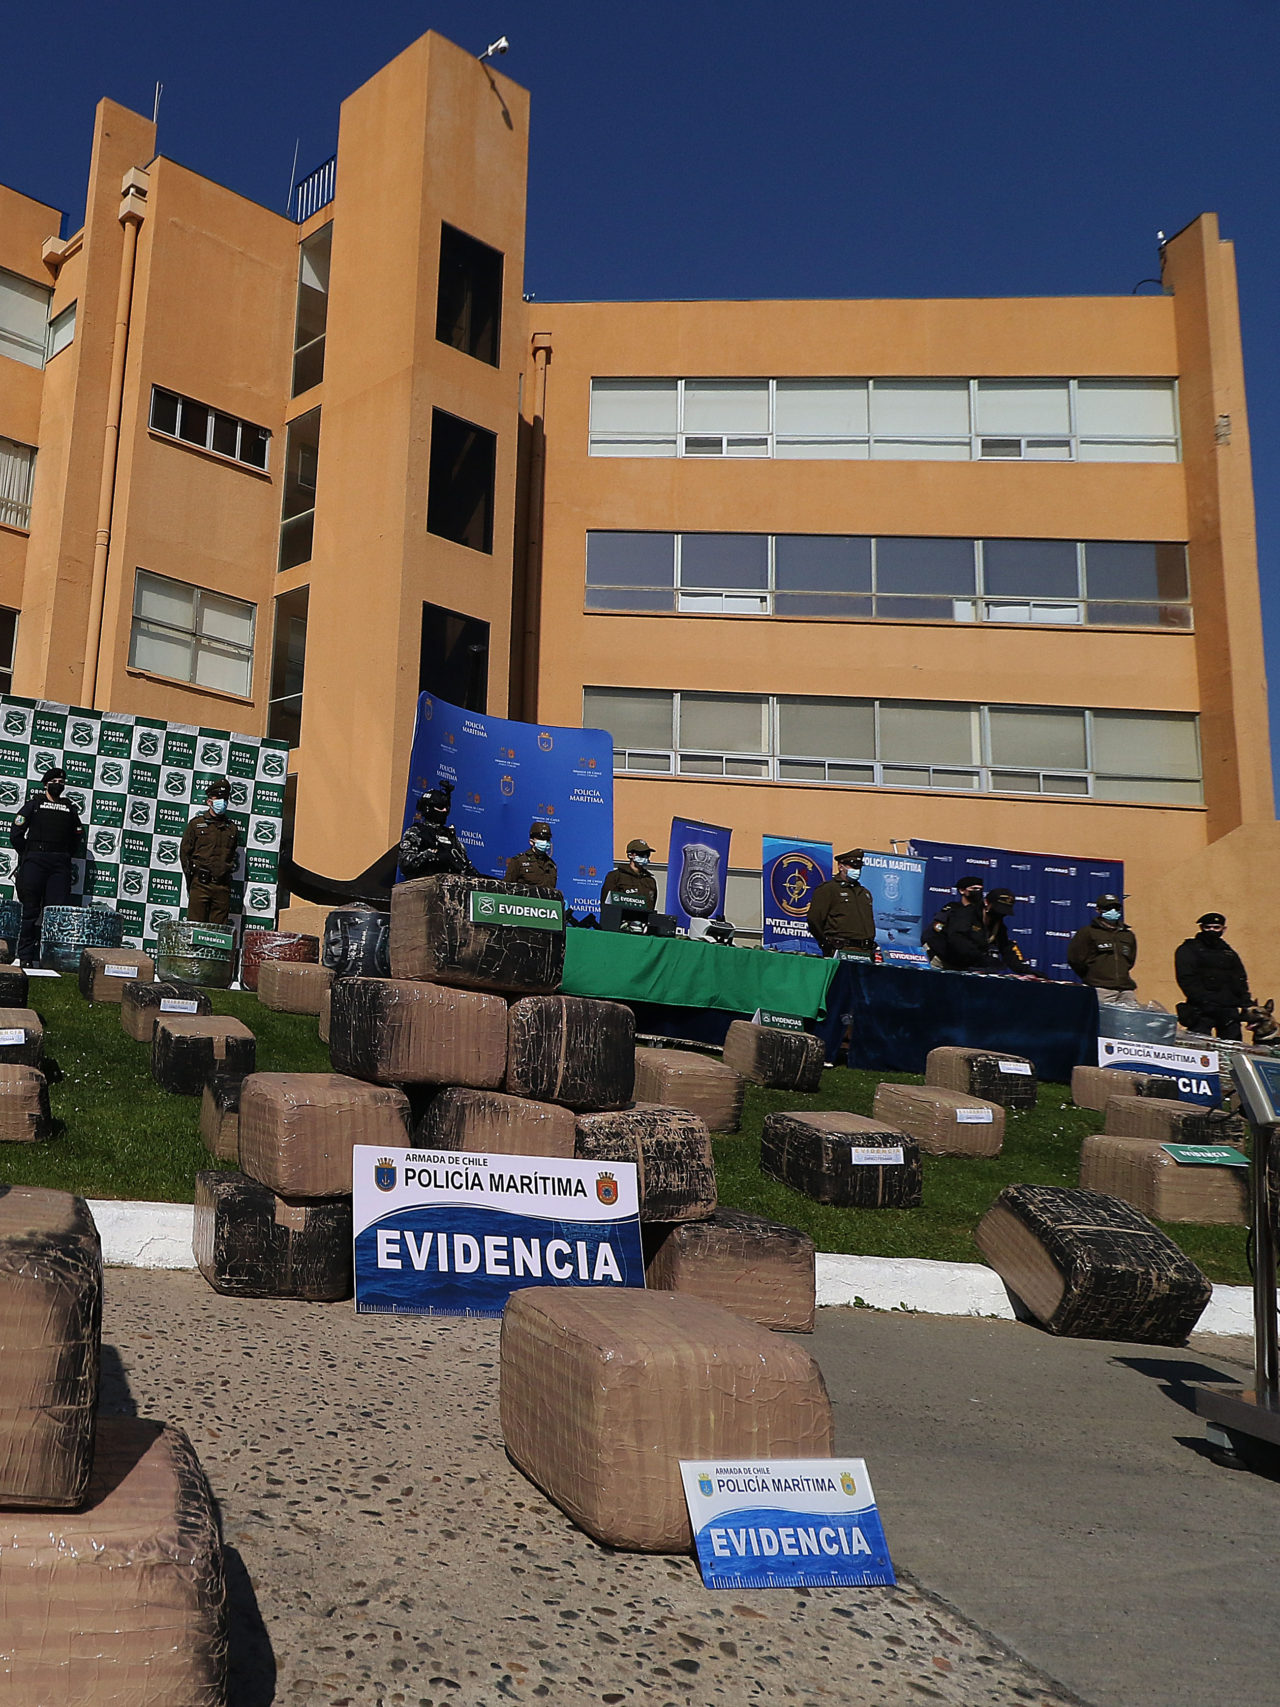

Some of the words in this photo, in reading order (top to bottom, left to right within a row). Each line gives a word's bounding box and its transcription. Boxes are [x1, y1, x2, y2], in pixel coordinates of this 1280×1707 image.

[466, 720, 484, 730] POLICÍA
[463, 727, 487, 738] MARÍTIMA
[570, 795, 604, 804] MARÍTIMA
[462, 830, 482, 839] POLICÍA
[889, 860, 921, 872] MARÍTIMA
[499, 904, 558, 919] EVIDENCIA
[198, 935, 225, 944] EVIDENCIA
[889, 952, 928, 962] EVIDENCIA
[1117, 1046, 1151, 1058] POLICÍA
[1153, 1052, 1197, 1064] MARÍTIMA
[405, 1153, 446, 1164] ARMADA
[448, 1156, 460, 1165] DE
[461, 1157, 489, 1167] CHILE
[404, 1167, 484, 1191] POLICÍA
[489, 1172, 587, 1197] MARÍTIMA
[376, 1229, 623, 1282] EVIDENCIA
[718, 1476, 770, 1493] POLICÍA
[773, 1476, 837, 1492] MARÍTIMA
[709, 1527, 872, 1557] EVIDENCIA
